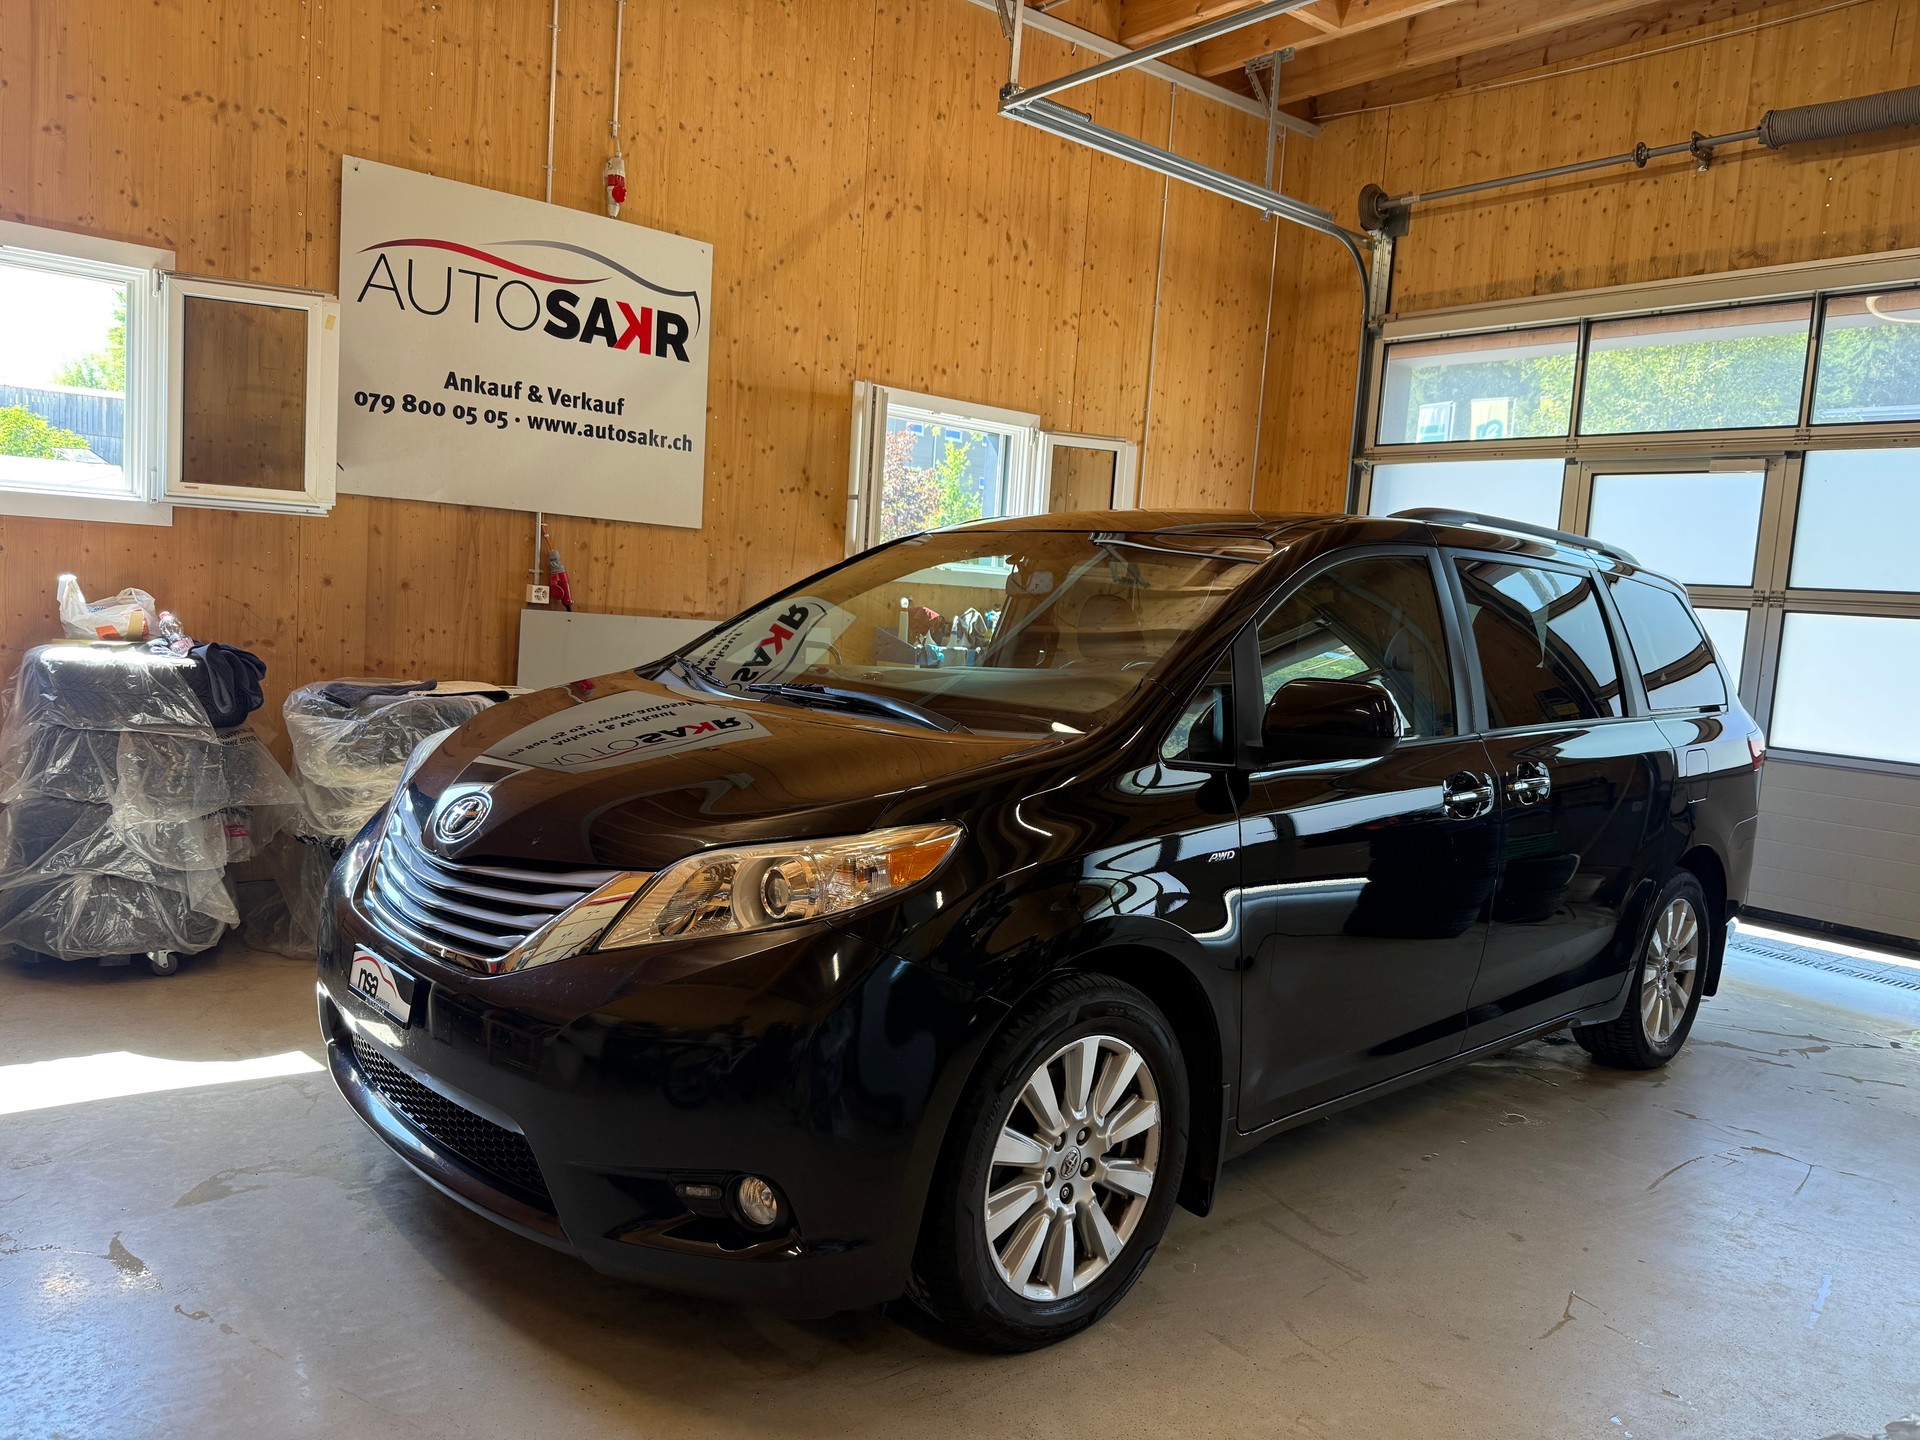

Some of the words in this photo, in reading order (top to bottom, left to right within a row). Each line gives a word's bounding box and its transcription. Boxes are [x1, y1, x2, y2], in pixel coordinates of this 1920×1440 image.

[357, 253, 690, 363] AUTOSAKR
[444, 371, 522, 400] Ankauf
[528, 385, 543, 403] &
[548, 386, 625, 416] Verkauf
[354, 390, 395, 414] 079
[402, 394, 446, 417] 800
[453, 404, 478, 425] 05
[484, 409, 508, 429] 05
[527, 413, 693, 452] www.autosakr.ch
[1208, 850, 1236, 862] AWD
[357, 967, 379, 999] nsa
